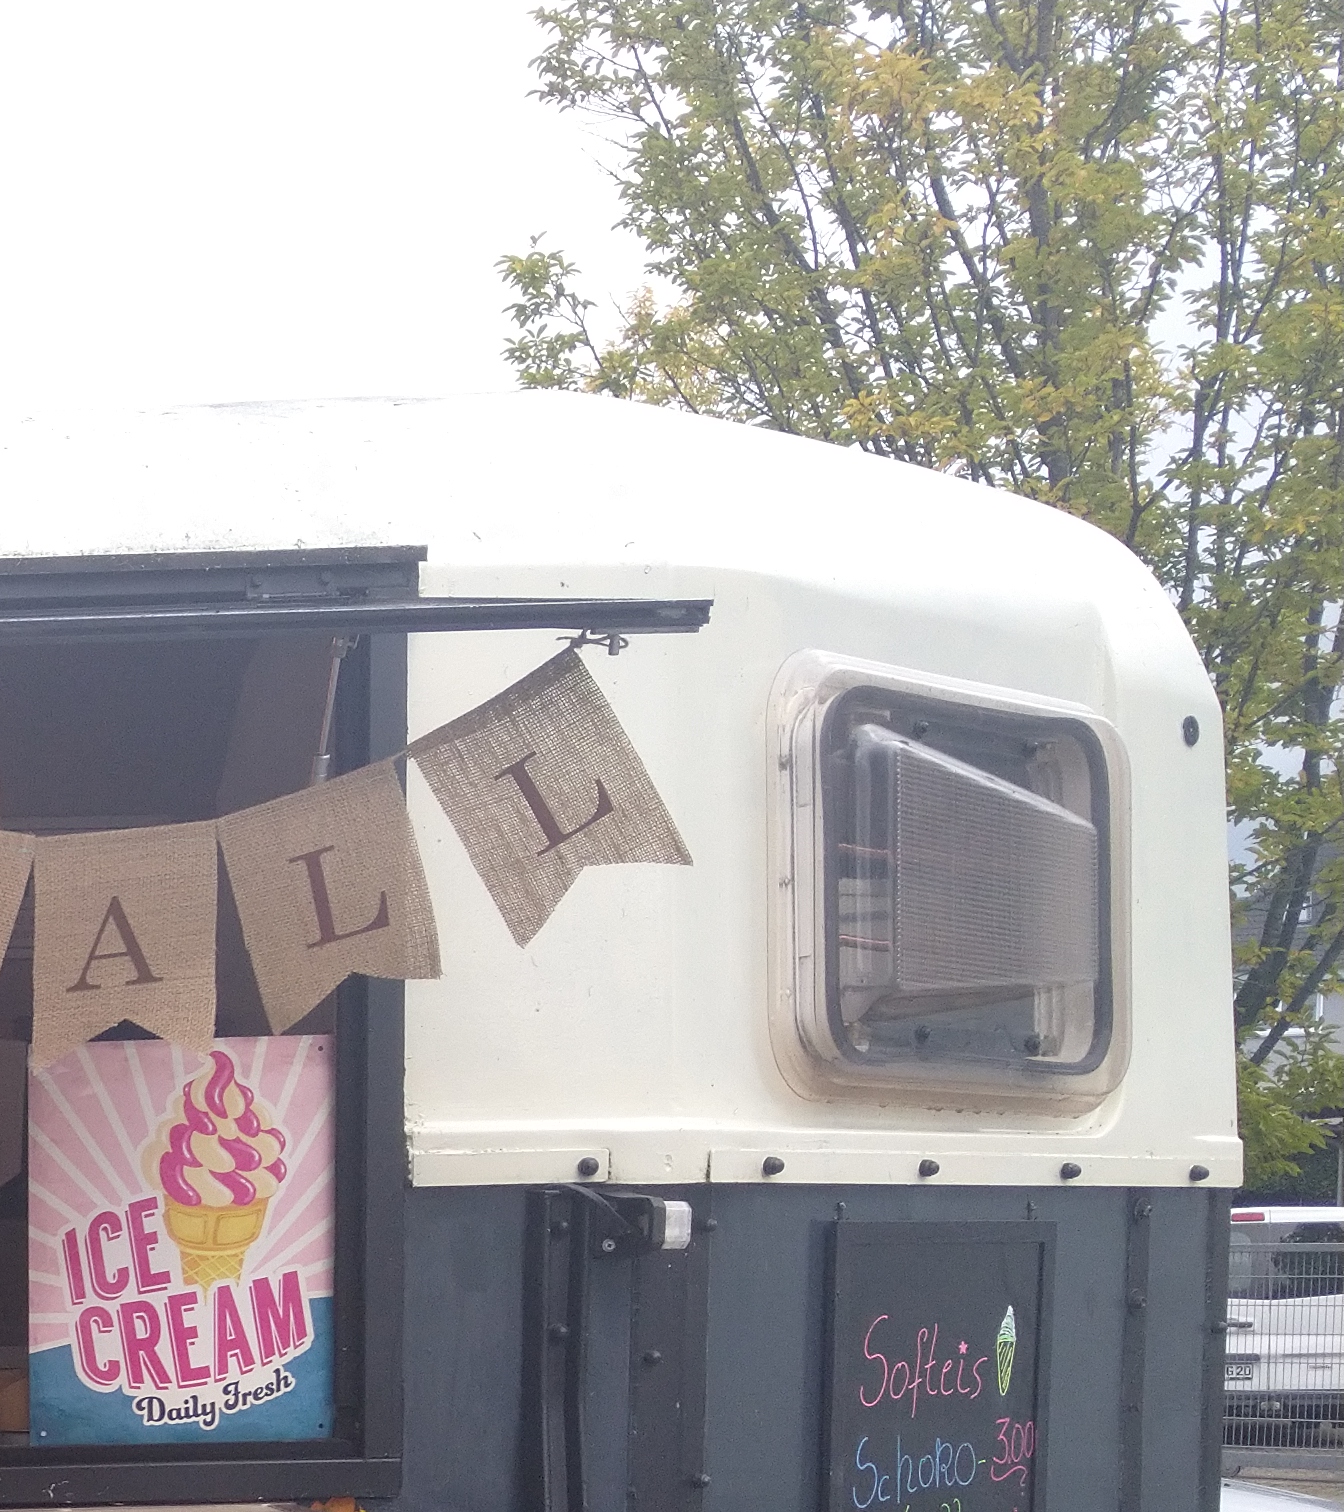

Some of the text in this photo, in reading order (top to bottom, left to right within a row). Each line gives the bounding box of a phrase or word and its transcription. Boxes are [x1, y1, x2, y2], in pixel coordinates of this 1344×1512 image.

[61, 1196, 172, 1307] ICE
[74, 1270, 309, 1392] CREAM
[859, 1314, 988, 1419] Softeis
[136, 1367, 292, 1427] Daily Fresh
